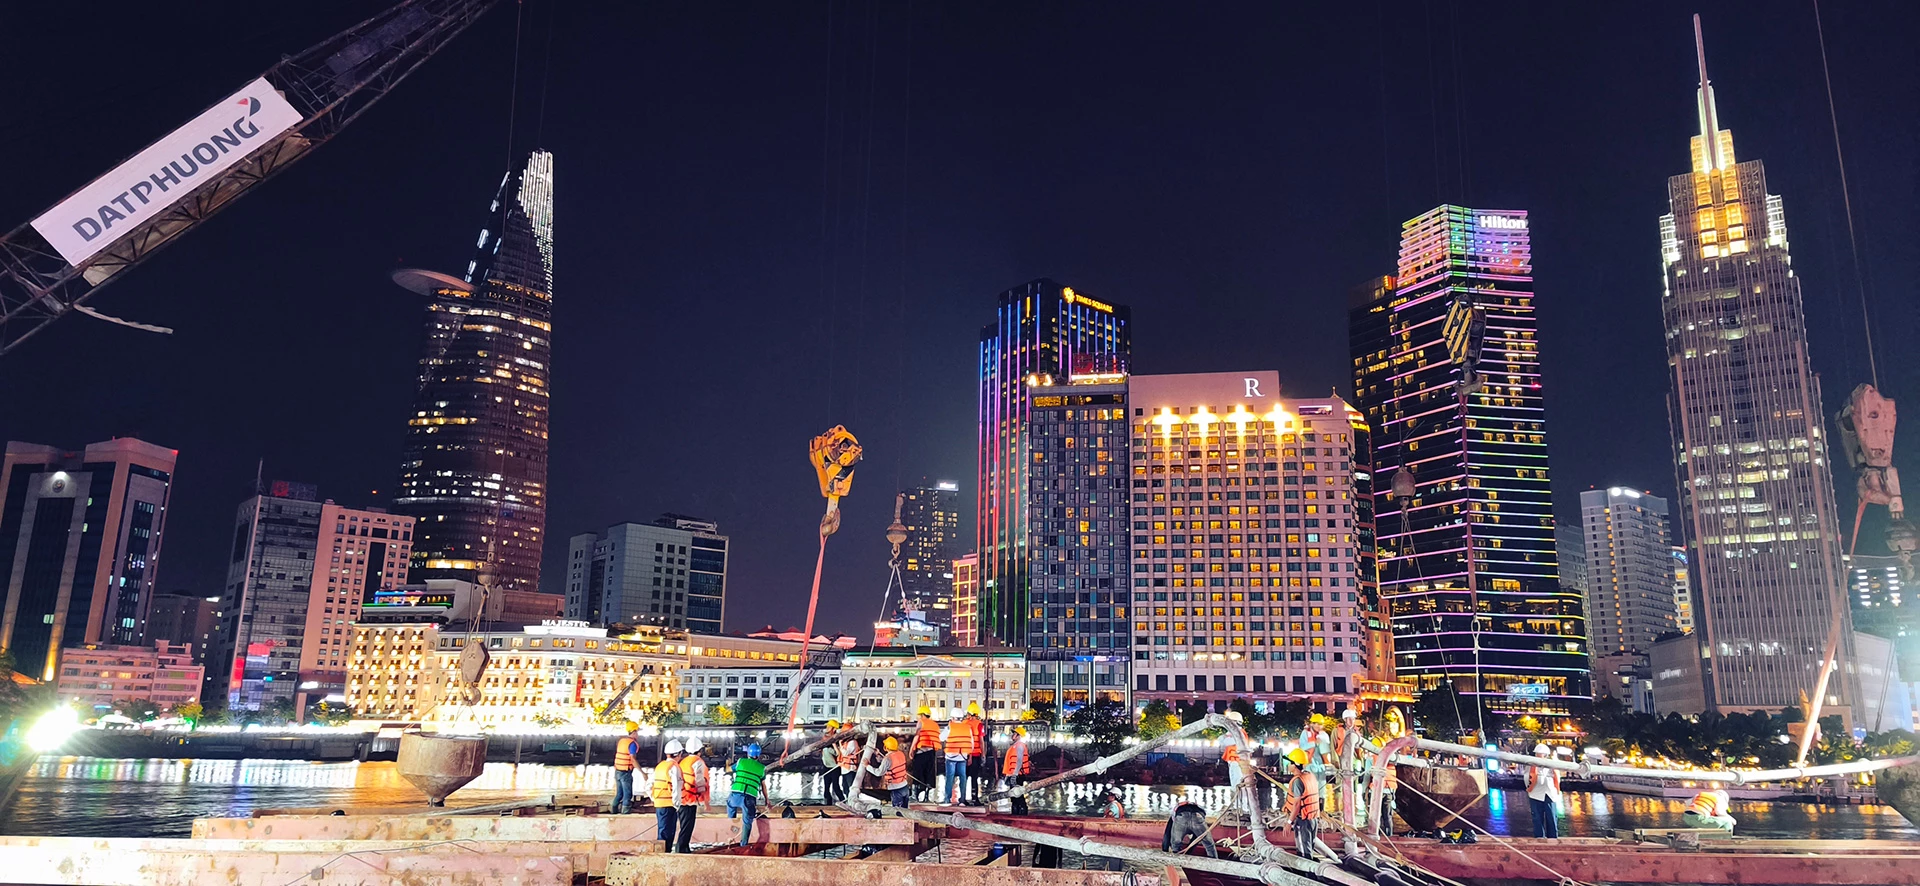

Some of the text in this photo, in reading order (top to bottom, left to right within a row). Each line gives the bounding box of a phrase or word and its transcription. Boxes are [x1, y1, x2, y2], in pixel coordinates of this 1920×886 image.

[72, 115, 260, 242] DATPHUONG
[1480, 215, 1527, 229] Hilton
[1075, 294, 1114, 313] TIMES SQUARE
[1243, 377, 1266, 398] R
[541, 619, 590, 629] MAJESTIC
